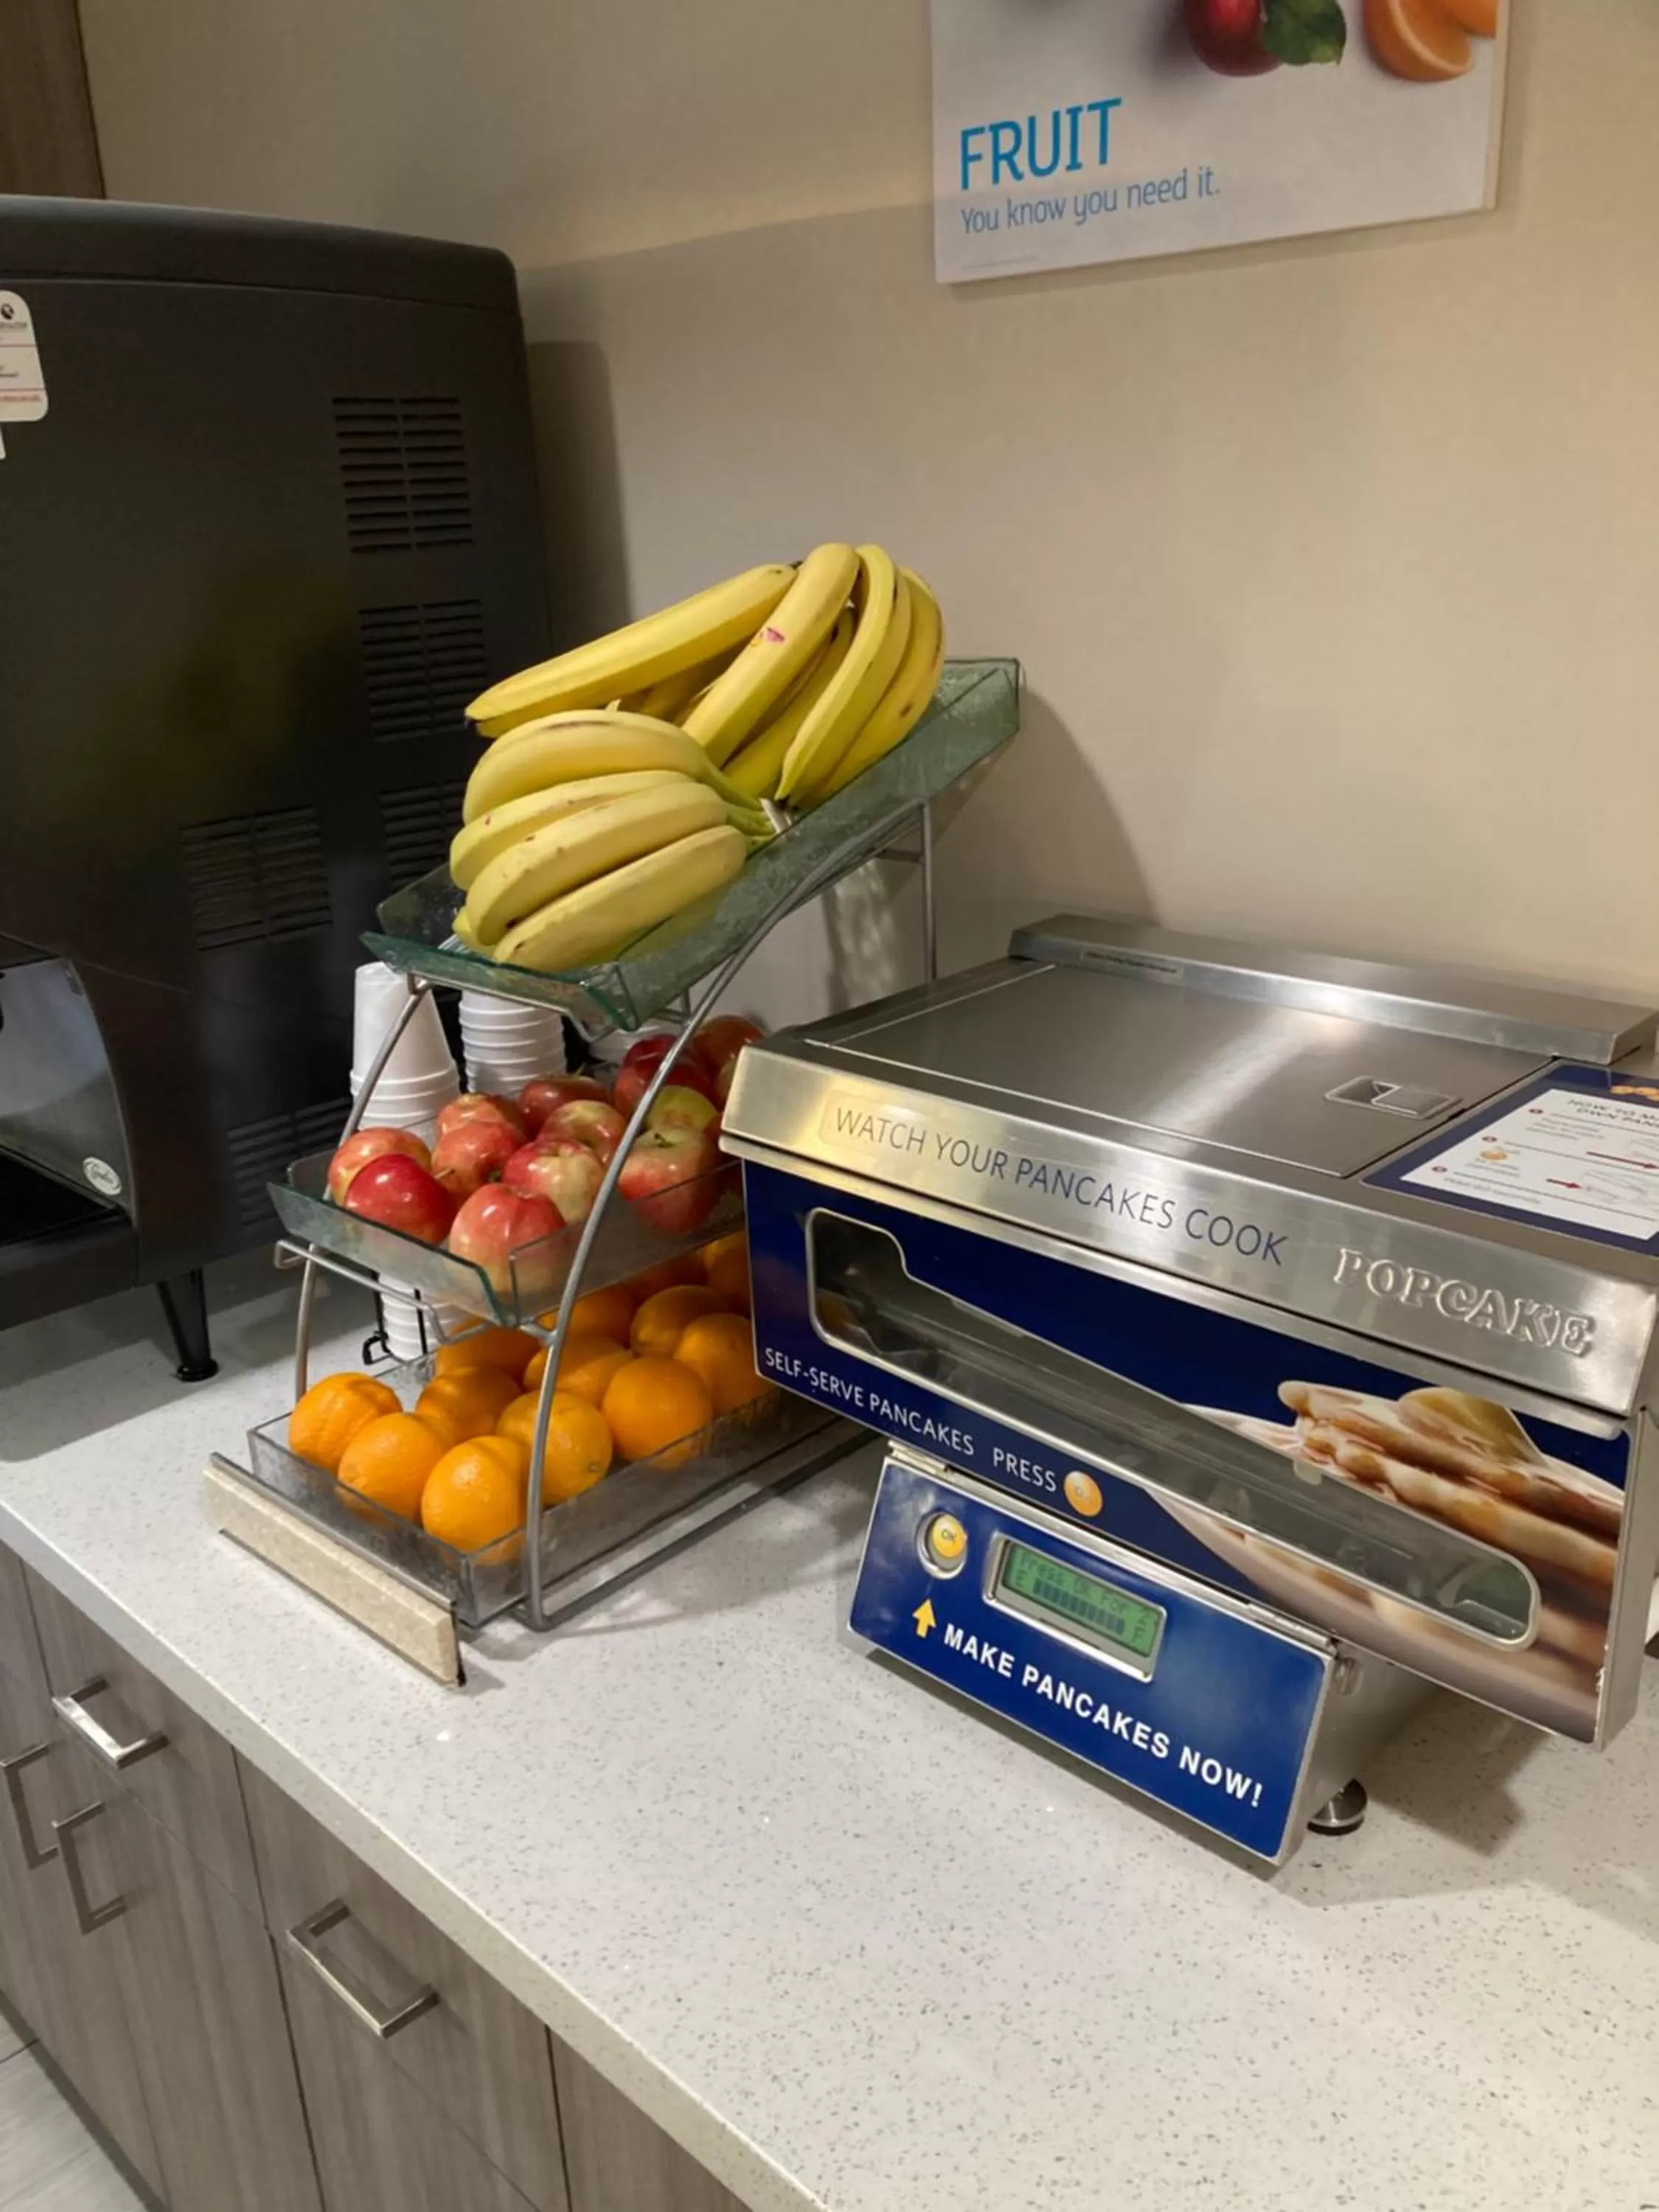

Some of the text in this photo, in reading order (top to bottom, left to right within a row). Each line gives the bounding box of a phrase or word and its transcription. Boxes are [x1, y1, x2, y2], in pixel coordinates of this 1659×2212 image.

[961, 97, 1121, 190] FRUIT
[961, 166, 1220, 234] You know you need it.
[835, 1107, 1289, 1267] WATCH YOUR PANCAKES COOK
[1333, 1248, 1596, 1357] POPCAKE
[765, 1346, 1057, 1492] SELF-SERVE PANCAKES PRESS
[943, 1622, 1264, 1807] MAKE PANCAKES NOW!
